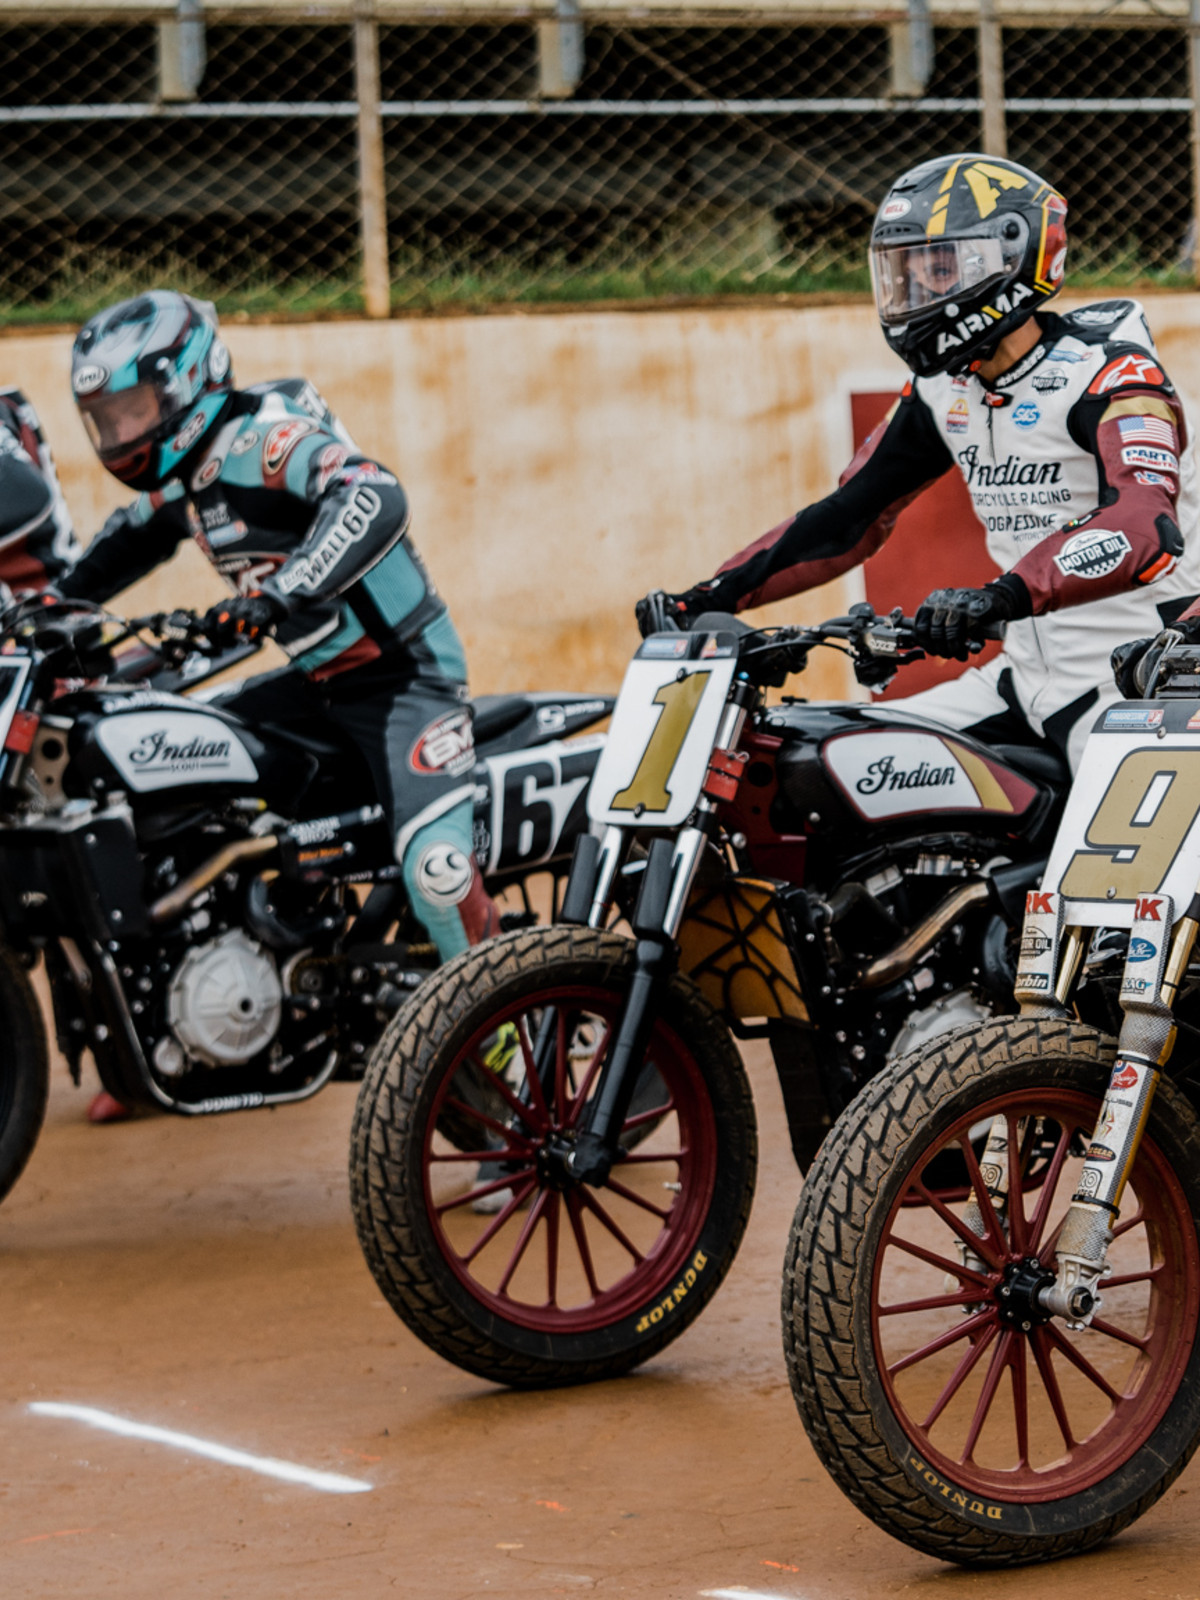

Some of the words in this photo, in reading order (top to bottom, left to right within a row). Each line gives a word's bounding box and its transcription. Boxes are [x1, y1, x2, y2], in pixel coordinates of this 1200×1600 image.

[958, 445, 1062, 487] Indian
[342, 489, 378, 541] 60
[1021, 488, 1072, 506] RACING
[985, 513, 1057, 532] OGRESSIVE
[1060, 543, 1105, 571] MOTOR
[1105, 535, 1126, 556] OIL
[128, 729, 231, 764] Indian
[609, 669, 713, 813] 1
[857, 757, 957, 795] Indian
[1035, 938, 1052, 950] OIL
[1017, 974, 1048, 988] orbin
[636, 1249, 708, 1334] DUNLOP
[909, 1457, 1004, 1520] DUNLOP
